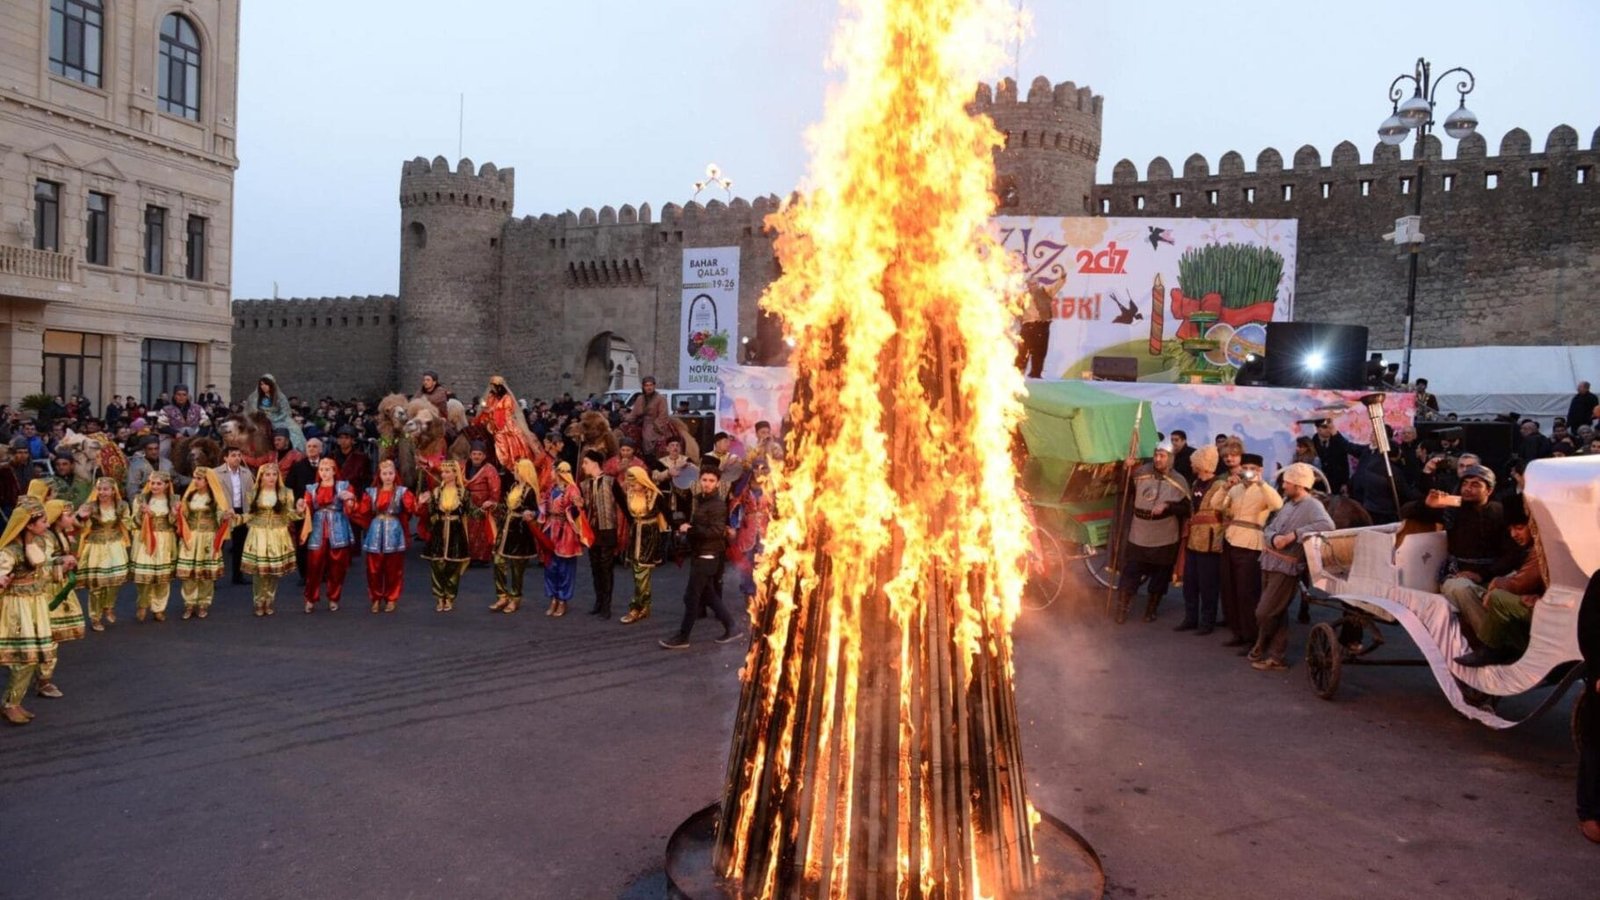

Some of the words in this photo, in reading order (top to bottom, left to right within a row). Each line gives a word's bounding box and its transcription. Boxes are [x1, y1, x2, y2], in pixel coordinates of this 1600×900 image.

[690, 258, 718, 268] BAHAR
[697, 267, 728, 278] QALASI
[689, 365, 718, 373] NOVRU
